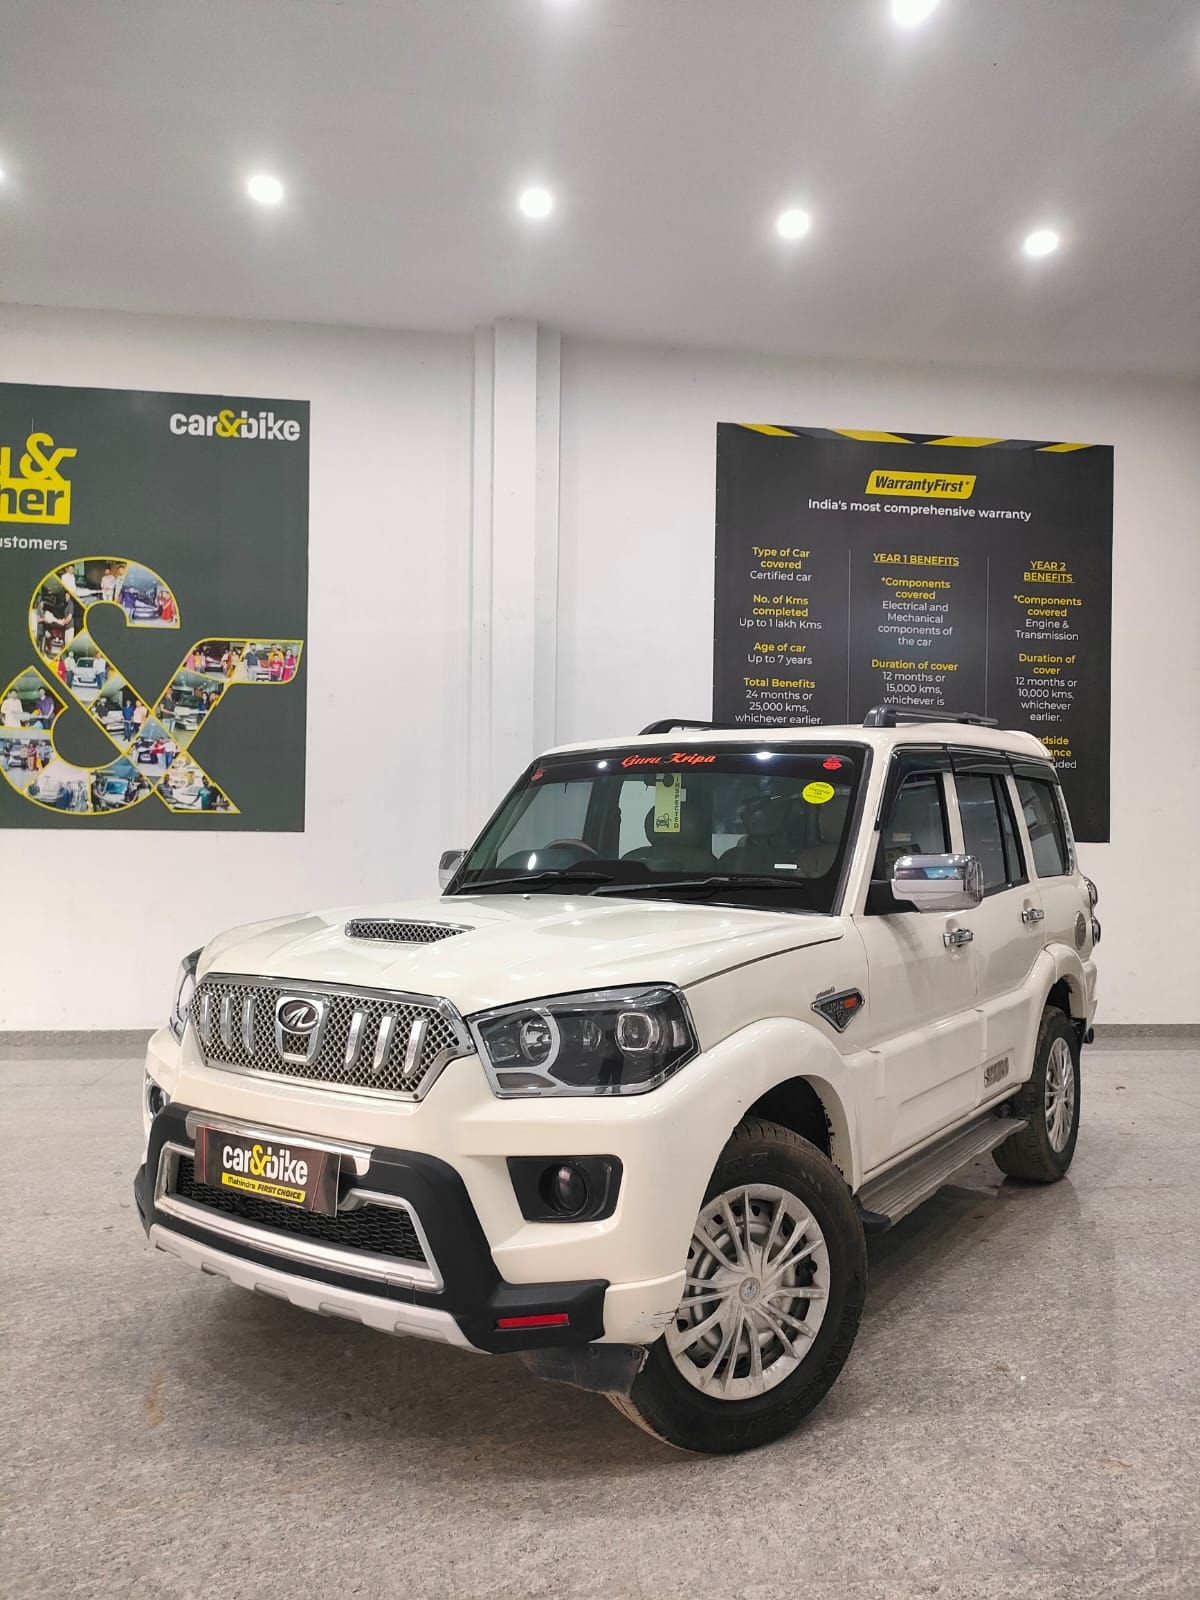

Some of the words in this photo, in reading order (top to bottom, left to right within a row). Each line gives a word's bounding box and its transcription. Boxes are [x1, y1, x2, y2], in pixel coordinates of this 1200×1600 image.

[169, 409, 300, 441] car&bike
[808, 498, 847, 511] India's
[850, 501, 881, 513] most
[884, 503, 976, 518] comprehensive
[978, 509, 1032, 522] warranty
[0, 536, 68, 551] stomers
[752, 546, 777, 557] Type
[780, 548, 791, 557] of
[792, 549, 810, 558] Car
[760, 560, 802, 569] covered
[873, 553, 901, 564] YEAR
[910, 555, 960, 567] BENEFITS
[1030, 560, 1058, 571] YEAR
[1060, 562, 1067, 571] 2
[749, 570, 794, 581] Certified
[796, 573, 812, 582] car
[1023, 572, 1074, 584] BENEFITS
[753, 594, 770, 604] No.
[772, 595, 783, 604] of
[786, 596, 809, 605] Kms
[895, 591, 936, 600] covered
[882, 600, 928, 611] Electrical
[929, 603, 949, 612] and
[752, 607, 809, 617] completed
[1027, 608, 1068, 617] covered
[739, 617, 754, 628] Up
[756, 619, 767, 627] to
[775, 619, 797, 629] lakh
[799, 620, 822, 630] Kms
[887, 612, 944, 624] Mechanical
[1025, 618, 1060, 629] Engine
[1062, 620, 1069, 629] &
[877, 625, 941, 635] components
[942, 626, 953, 636] of
[1015, 630, 1079, 641] Transmission
[753, 642, 775, 653] Age
[777, 643, 788, 652] of
[789, 645, 807, 653] car
[898, 637, 915, 646] the
[916, 638, 933, 647] car
[747, 653, 763, 664] Up
[765, 654, 776, 663] to
[778, 654, 784, 664] 7
[785, 657, 813, 666] years
[1018, 653, 1063, 664] Duration
[1065, 655, 1077, 664] of
[871, 659, 916, 670] Duration
[917, 661, 929, 670] of
[930, 663, 959, 671] cover
[882, 671, 893, 681] 12
[894, 672, 934, 682] months
[1033, 667, 1061, 675] cover
[743, 677, 769, 687] Total
[771, 679, 816, 688] Benefits
[1015, 676, 1025, 686] 12
[1027, 677, 1066, 687] months
[745, 689, 759, 699] 24
[760, 690, 801, 700] months
[802, 692, 814, 700] or
[885, 683, 917, 694] 15,000
[919, 684, 943, 695] kms,
[1017, 688, 1050, 698] 10,000
[1051, 689, 1075, 700] kms,
[883, 695, 935, 705] whichever
[936, 697, 945, 706] is
[1020, 700, 1072, 710] whichever
[749, 701, 783, 712] 25,000
[785, 702, 809, 713] kms,
[735, 713, 787, 724] whichever
[789, 715, 824, 725] earlier.
[1029, 712, 1063, 722] earlier.
[621, 754, 662, 768] Guru
[663, 752, 717, 765] Kripa
[673, 776, 681, 829] INSPECTED
[222, 1144, 309, 1186] car&bike
[227, 1175, 256, 1190] Mahindra
[257, 1183, 276, 1195] FIRST
[276, 1188, 302, 1200] CHOICE
